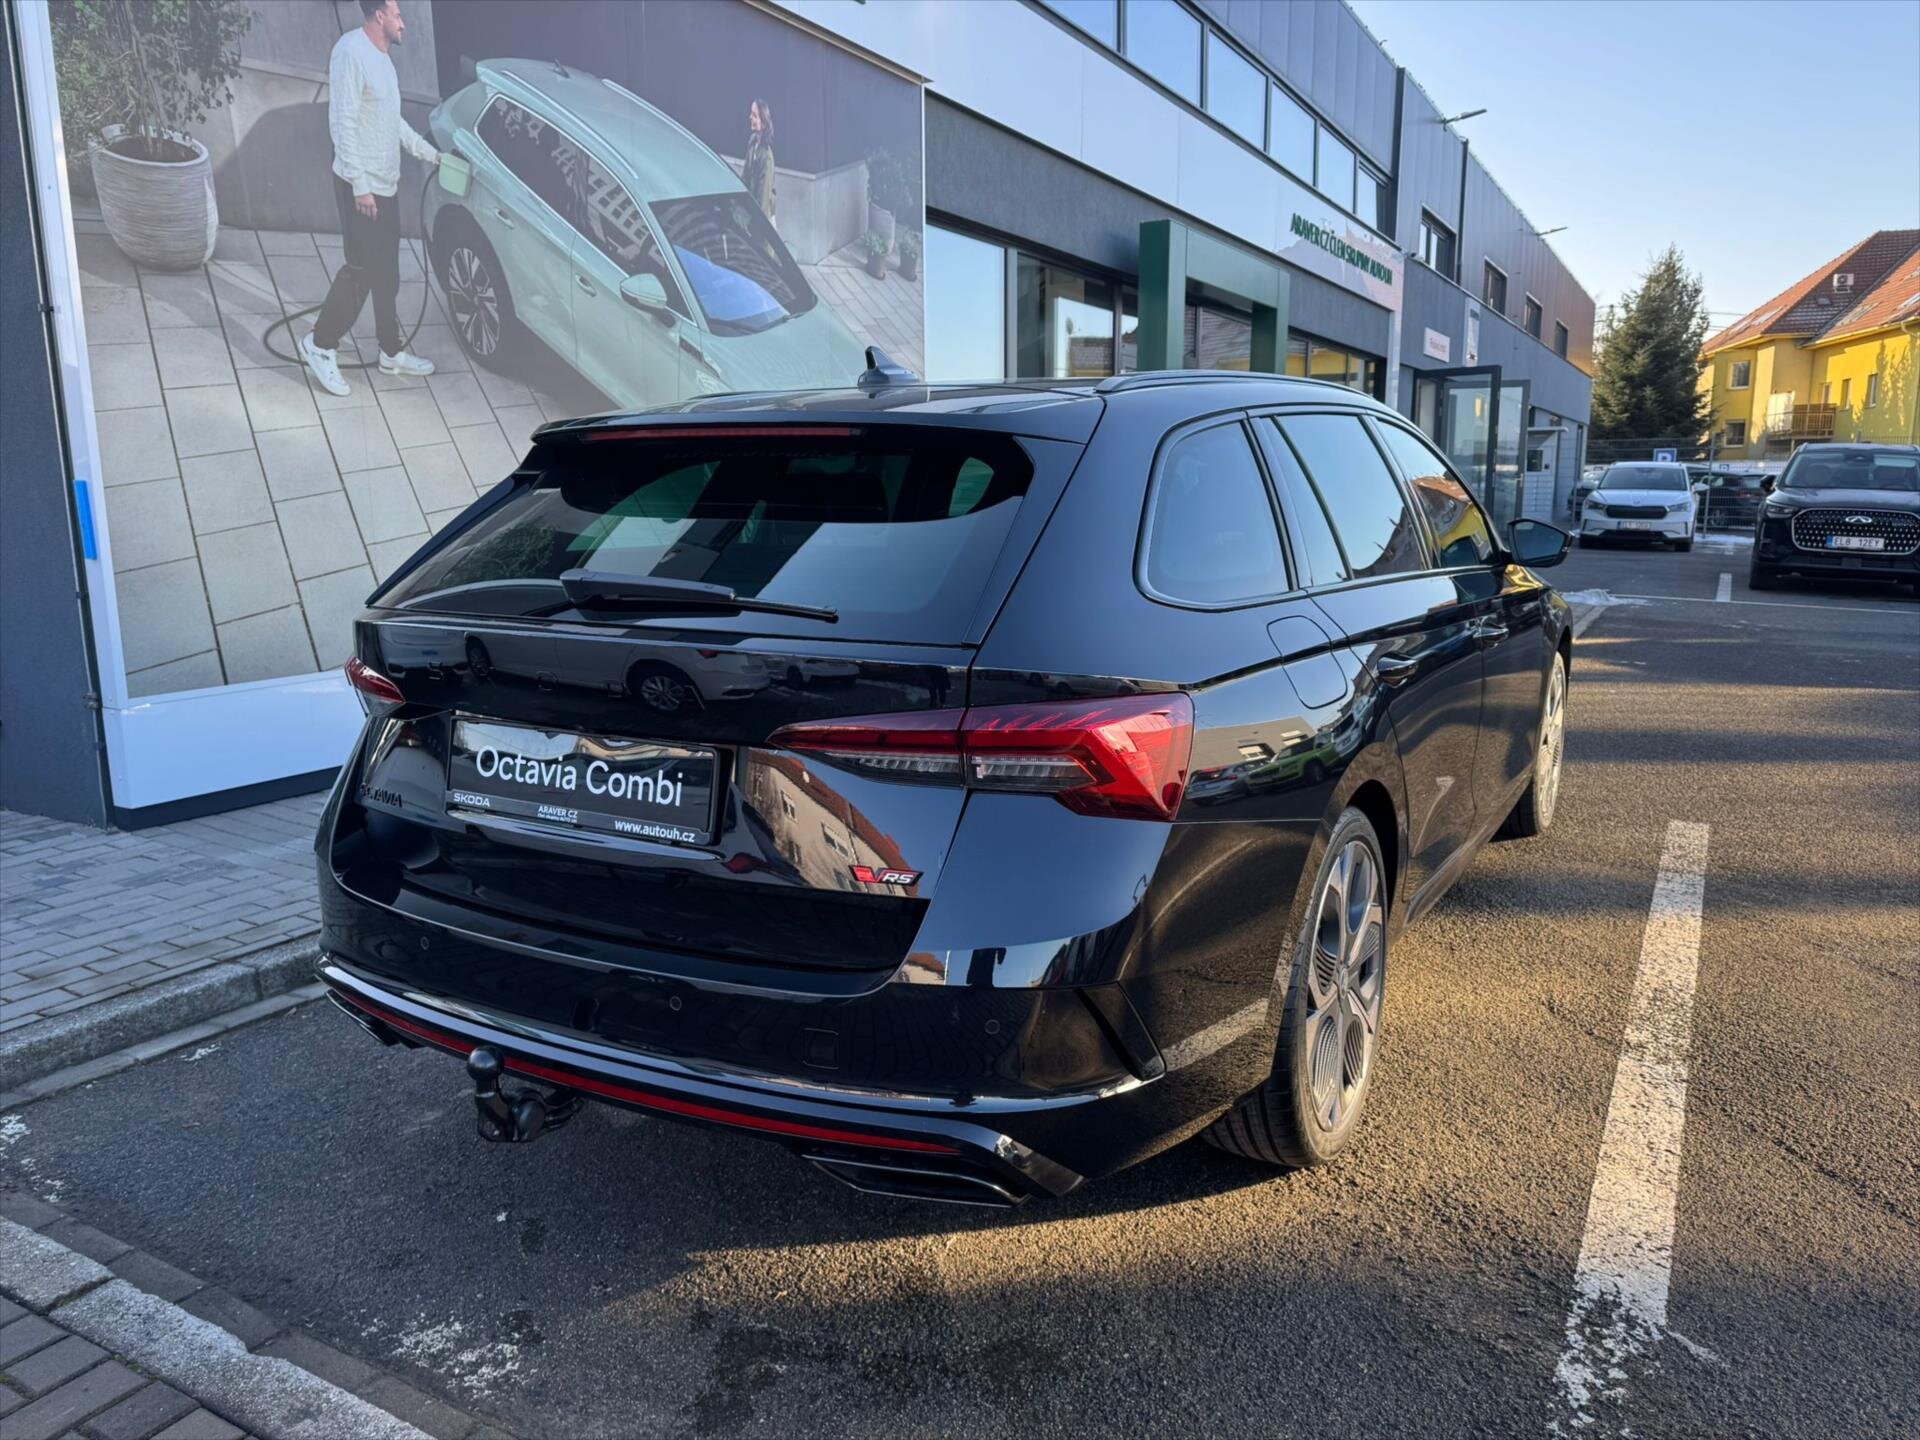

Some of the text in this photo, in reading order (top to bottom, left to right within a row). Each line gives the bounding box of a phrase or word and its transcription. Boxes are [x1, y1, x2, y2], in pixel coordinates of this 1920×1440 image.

[476, 745, 684, 807] Octavia Combi
[538, 805, 567, 817] ARAVER
[567, 810, 578, 819] CZ
[614, 820, 695, 843] www.autouh.cz
